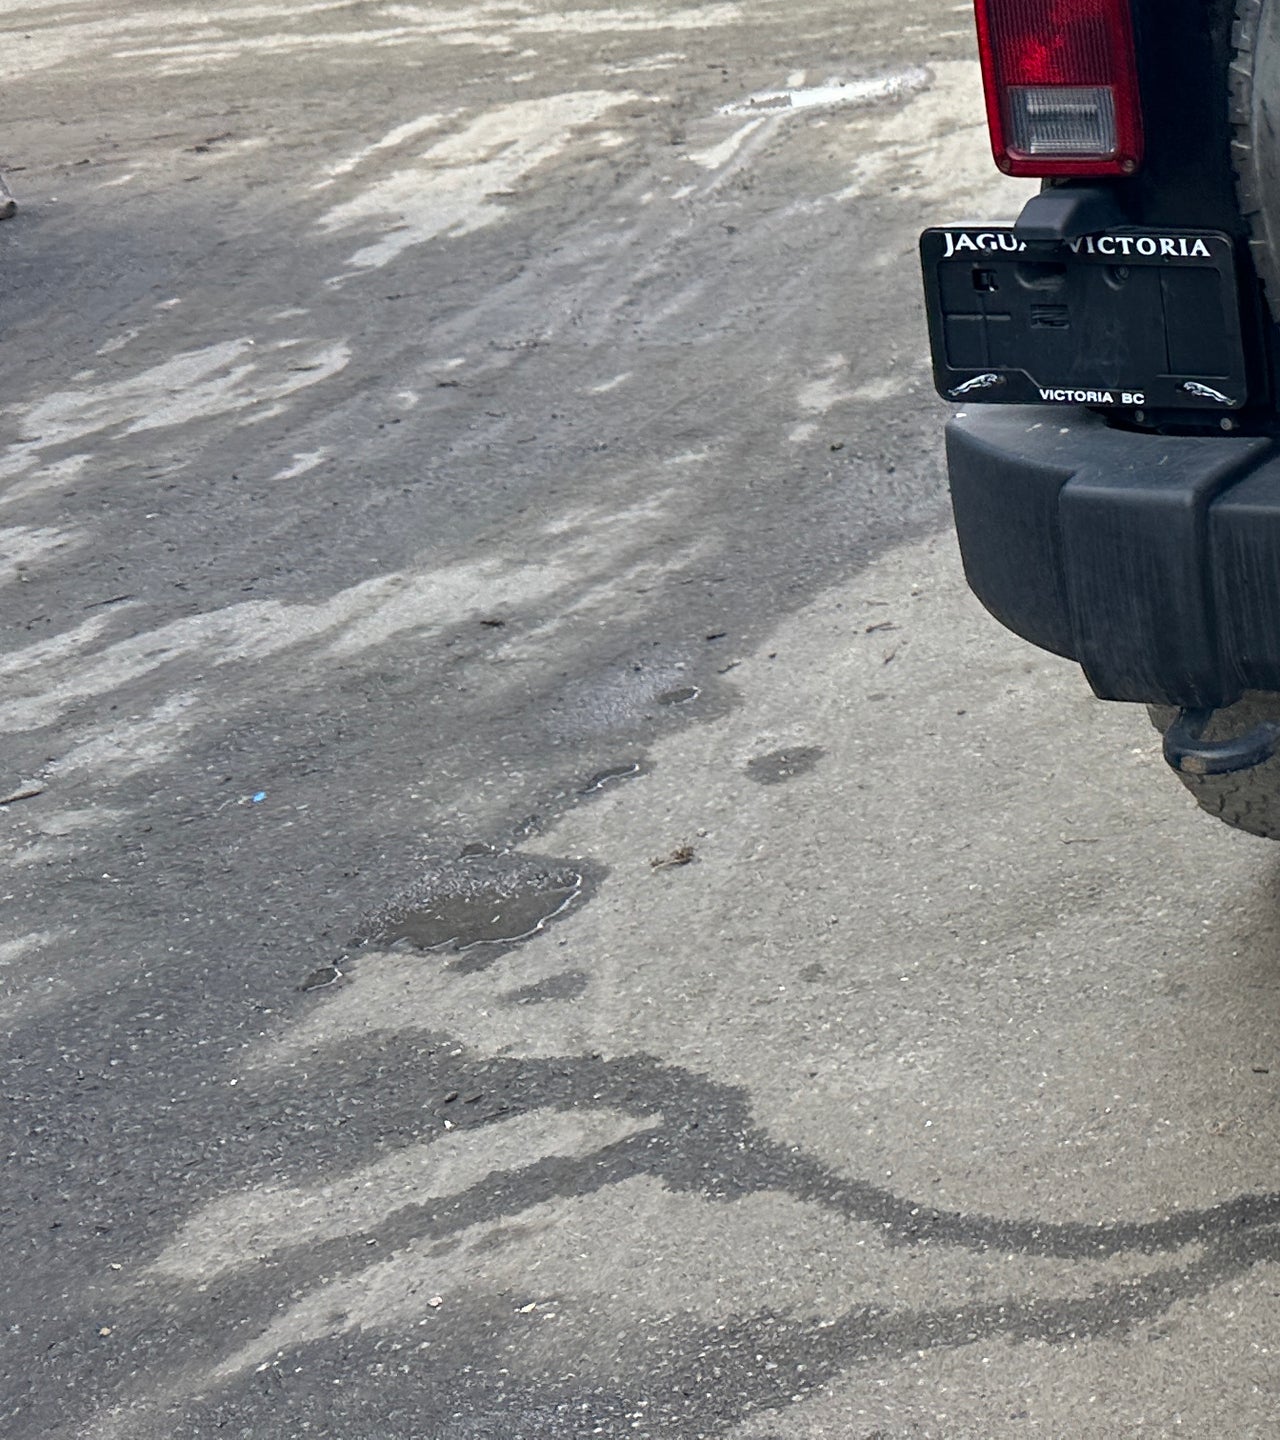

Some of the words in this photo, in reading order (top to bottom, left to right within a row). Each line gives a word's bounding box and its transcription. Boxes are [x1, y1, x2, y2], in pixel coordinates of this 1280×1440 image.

[943, 232, 1027, 258] JAGU
[1068, 236, 1211, 258] VICTORIA
[1039, 388, 1114, 404] VICTORIA
[1121, 392, 1145, 405] BC
